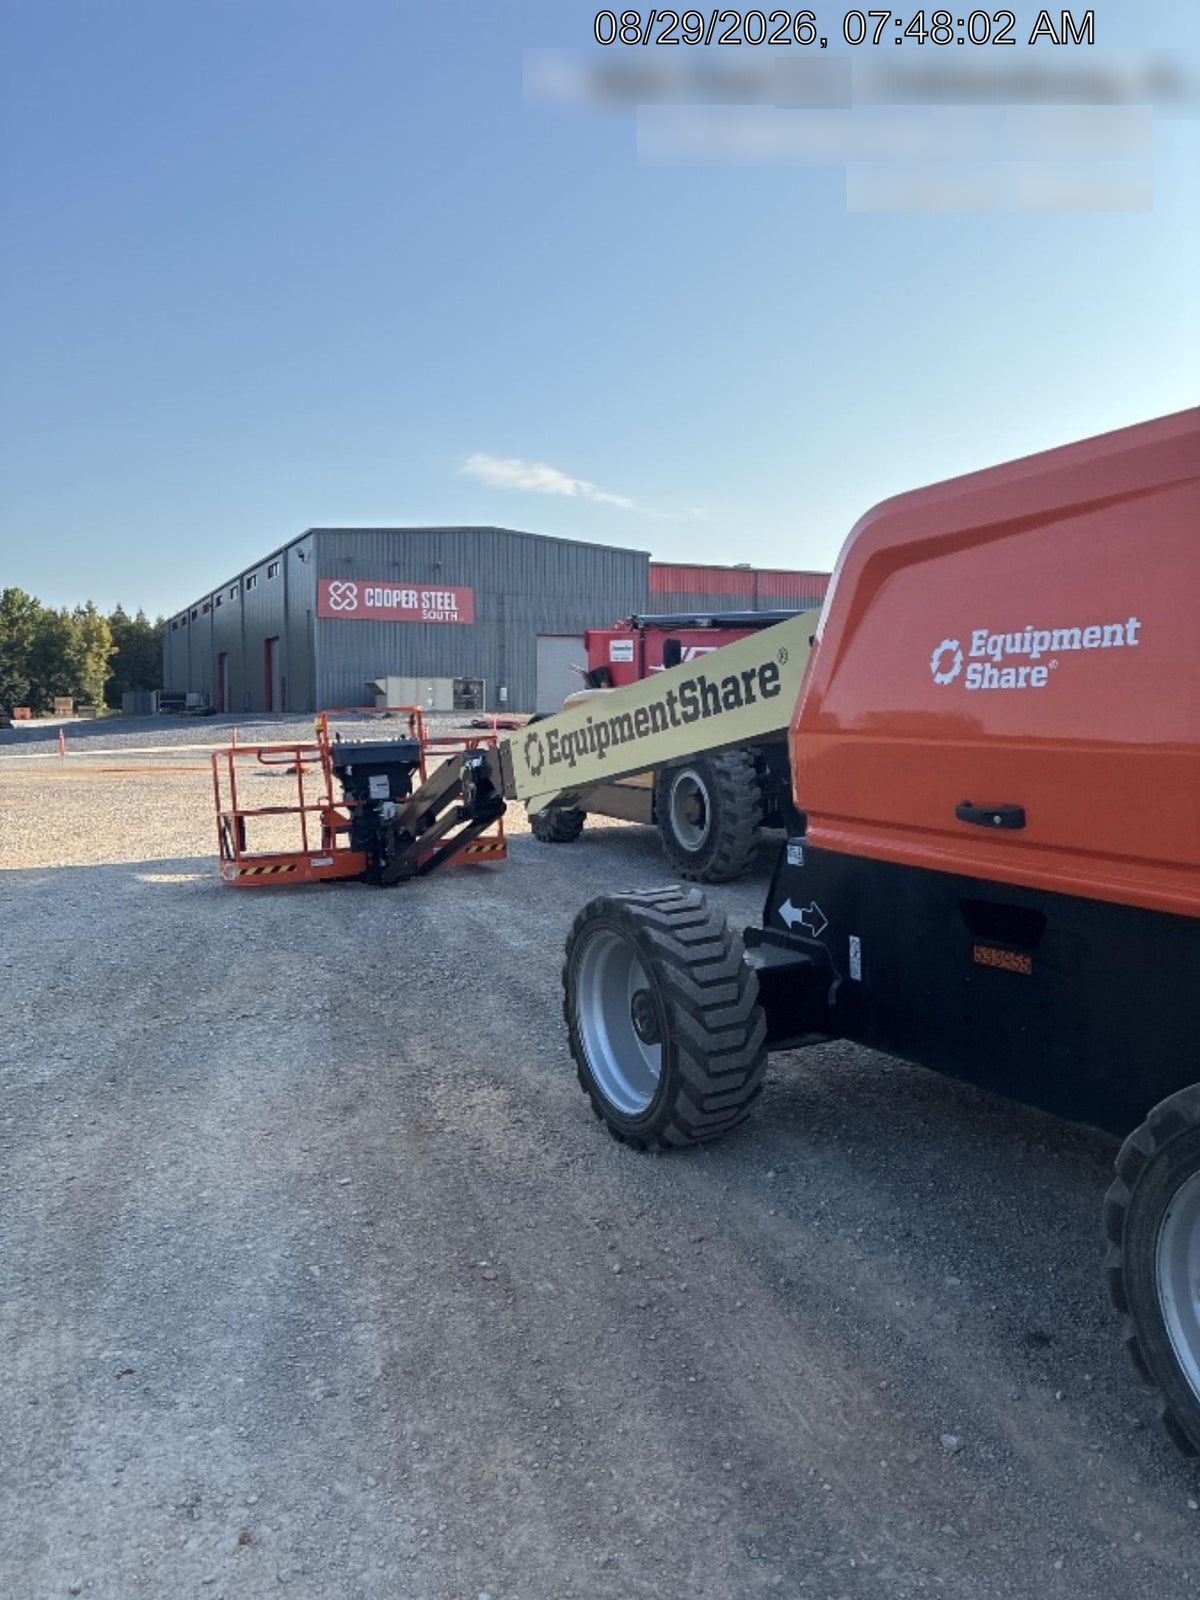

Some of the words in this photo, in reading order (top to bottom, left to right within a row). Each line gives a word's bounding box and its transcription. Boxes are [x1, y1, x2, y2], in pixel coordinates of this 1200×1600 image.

[364, 588, 419, 609] COOPER
[421, 591, 459, 611] STEEL
[421, 609, 459, 622] SOUTH
[968, 616, 1142, 662] Equipment
